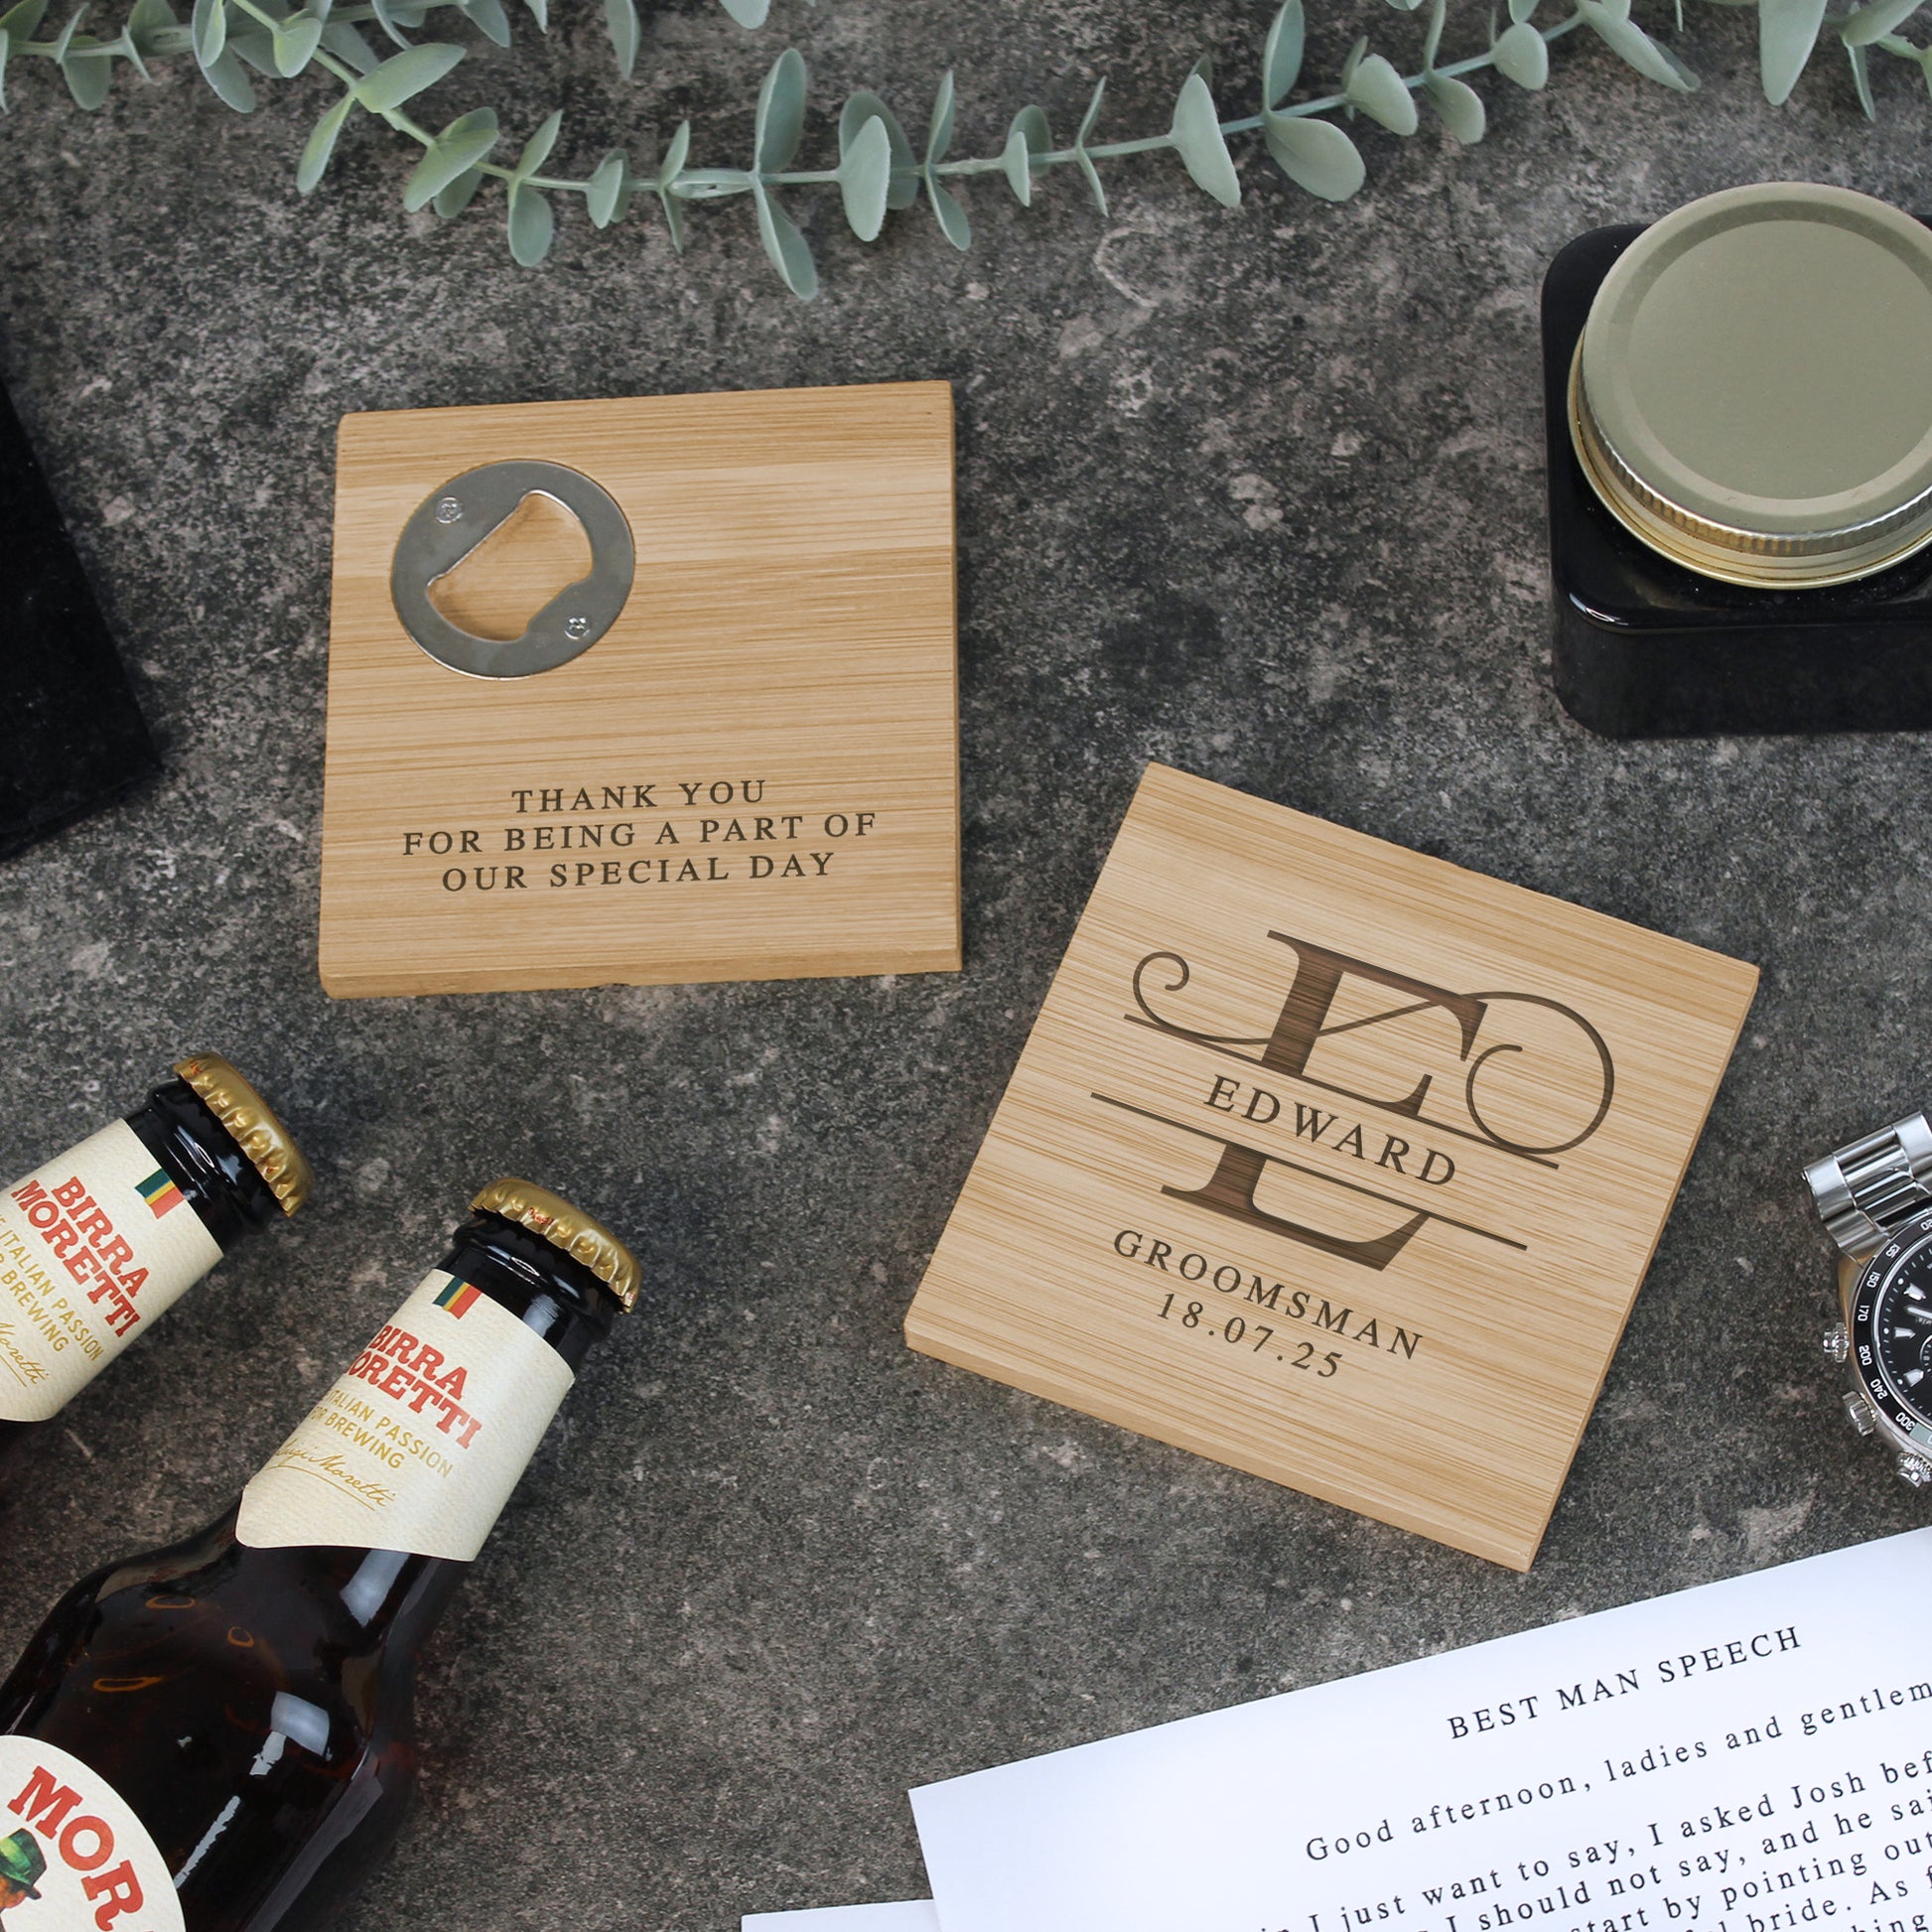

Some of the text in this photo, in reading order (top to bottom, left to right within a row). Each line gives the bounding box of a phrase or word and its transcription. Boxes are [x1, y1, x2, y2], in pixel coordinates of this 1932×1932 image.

[403, 813, 875, 855] FOR BEING A PART OF
[512, 780, 765, 813] THANK YOU
[443, 853, 834, 892] OUR SPECIAL DAY
[1203, 1074, 1455, 1185] EDWARD
[10, 1179, 141, 1337] MORETTI
[52, 1175, 150, 1298] BIRRA
[0, 1229, 104, 1361] ITALIAN PASSION
[1, 1269, 69, 1352] BREWING
[1114, 1230, 1423, 1359] GROOMSMAN
[1858, 1305, 1869, 1321] 170
[1866, 1271, 1881, 1288] 150
[368, 1324, 468, 1402] BIRRA
[1158, 1294, 1342, 1377] 18.07.25
[1859, 1344, 1872, 1366] 200
[344, 1351, 483, 1449] ORETTI
[1869, 1378, 1887, 1400] 240
[1895, 1412, 1916, 1431] 300
[325, 1412, 405, 1468] BREWING
[374, 1416, 454, 1478] PASSION
[1448, 1627, 1800, 1738] BEST MAN SPEECH
[1307, 1820, 1393, 1860] Good
[1413, 1778, 1589, 1833] afternoon,
[1605, 1742, 1707, 1781] ladies
[1726, 1717, 1781, 1748] and
[1341, 1896, 1405, 1932] just
[1423, 1870, 1501, 1904] want
[1518, 1861, 1548, 1880] to
[1569, 1841, 1634, 1867] say,
[1648, 1824, 1662, 1846] I
[1681, 1794, 1774, 1837] asked
[1792, 1772, 1864, 1808] Josh
[1479, 1881, 1590, 1930] should
[1608, 1866, 1661, 1895] not
[1680, 1850, 1744, 1876] say,
[1762, 1821, 1818, 1855] and
[1835, 1814, 1871, 1835] he
[1663, 1896, 1700, 1919] by
[1722, 1854, 1866, 1910] pointing
[1747, 1898, 1851, 1932] bride.
[1870, 1881, 1907, 1904] As
